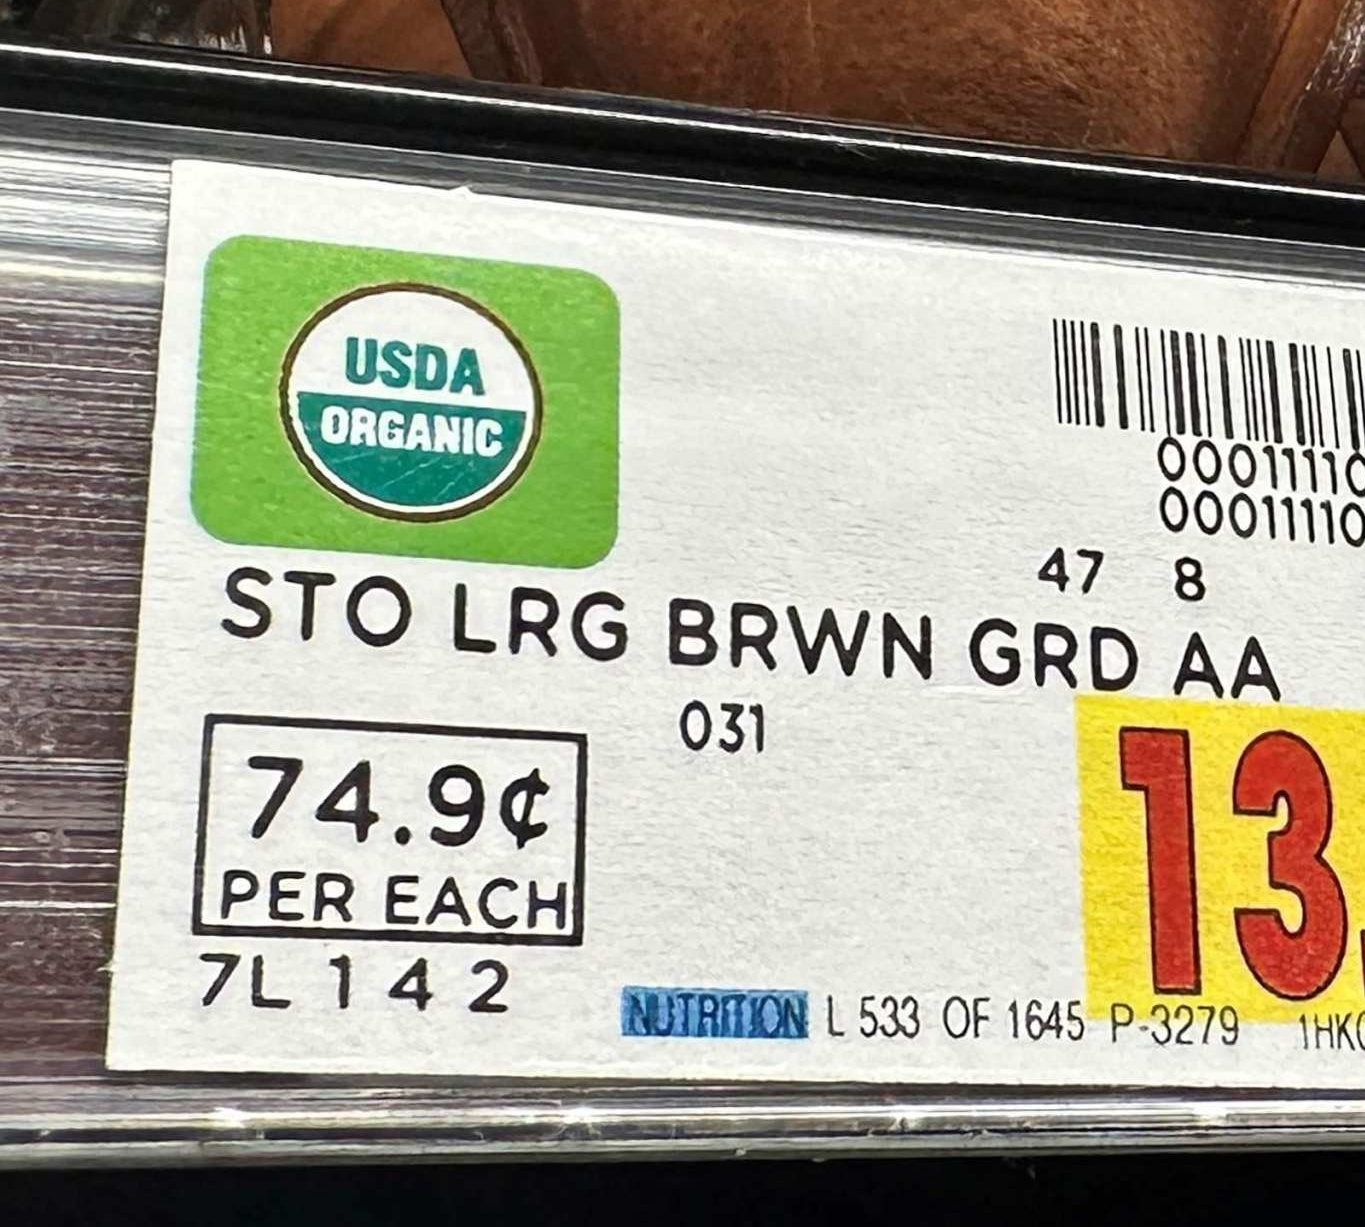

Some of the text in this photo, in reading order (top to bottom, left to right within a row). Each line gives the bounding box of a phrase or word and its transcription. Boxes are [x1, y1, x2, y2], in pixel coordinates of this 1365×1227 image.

[344, 336, 485, 397] USDA
[320, 406, 503, 459] ORGANIC
[1038, 548, 1104, 594] 47
[1174, 558, 1206, 602] 8
[221, 568, 412, 648] STO
[453, 583, 628, 663] LRG
[669, 599, 933, 681] BRWN
[969, 618, 1140, 693] GRD
[1173, 632, 1282, 702] AA
[679, 701, 767, 755] 031
[246, 756, 552, 848] 74.9¢
[220, 871, 568, 933] PER EACH
[199, 953, 510, 1015] 7L 1 4 2
[625, 990, 809, 1037] NUTRITION
[826, 994, 845, 1037] L
[860, 995, 921, 1039] 533
[942, 995, 991, 1039] OF
[1007, 998, 1086, 1042] 1645
[1110, 1004, 1240, 1046] P-3279
